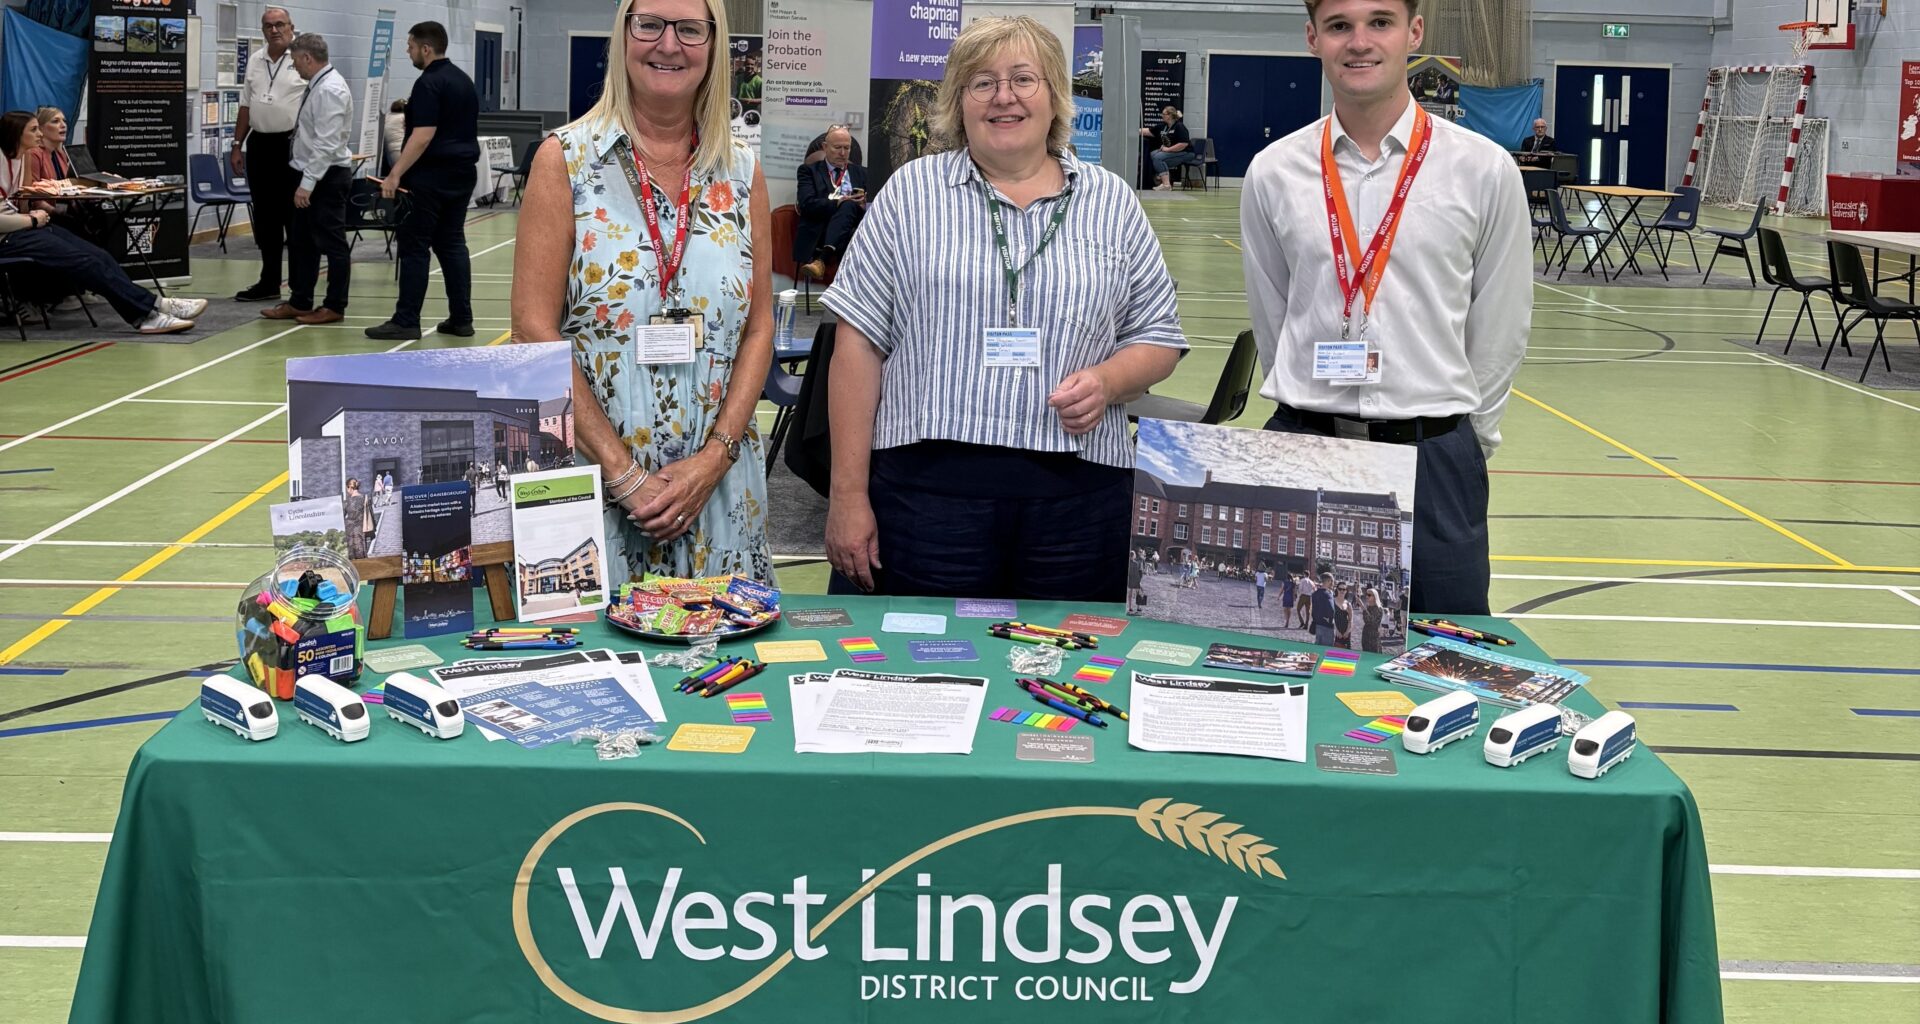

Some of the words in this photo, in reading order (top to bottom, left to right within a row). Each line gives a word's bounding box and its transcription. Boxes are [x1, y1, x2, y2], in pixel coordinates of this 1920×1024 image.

[910, 2, 958, 23] chapman
[768, 29, 790, 40] Join
[793, 30, 811, 41] the
[928, 22, 958, 40] rollits
[768, 44, 822, 56] Probation
[899, 51, 904, 62] A
[905, 54, 920, 62] new
[767, 59, 807, 70] Service
[1416, 140, 1429, 162] VISITOR
[625, 168, 637, 186] STAFF
[638, 160, 648, 186] VISITOR
[1398, 175, 1413, 199] VISITOR
[646, 198, 656, 226] VISITOR
[1832, 200, 1858, 210] Lancaster
[1832, 209, 1858, 220] University
[679, 204, 688, 229] VISITOR
[993, 212, 1003, 235] VISITOR
[1331, 213, 1339, 238] VISITOR
[1379, 212, 1395, 235] VISITOR
[1043, 221, 1058, 242] VISITOR
[1382, 232, 1391, 250] STAFF
[672, 241, 684, 268] VISITOR
[1001, 246, 1012, 270] VISITOR
[1360, 250, 1376, 273] VISITOR
[1338, 253, 1346, 280] VISITOR
[1371, 272, 1380, 290] STAFF
[364, 437, 404, 446] SAVOY
[289, 511, 326, 521] Lincolnshire
[298, 649, 314, 664] 50
[1440, 641, 1559, 674] GAINSBOROUGH
[439, 664, 475, 675] West
[477, 662, 522, 672] Lindsey
[840, 670, 872, 678] West
[873, 674, 918, 683] Lindsey
[1137, 675, 1167, 685] West
[1169, 678, 1216, 689] Lindsey
[557, 867, 828, 961] West
[862, 863, 1238, 995] Lindsey
[862, 974, 998, 1000] DISTRICT
[1015, 974, 1154, 1002] COUNCIL
